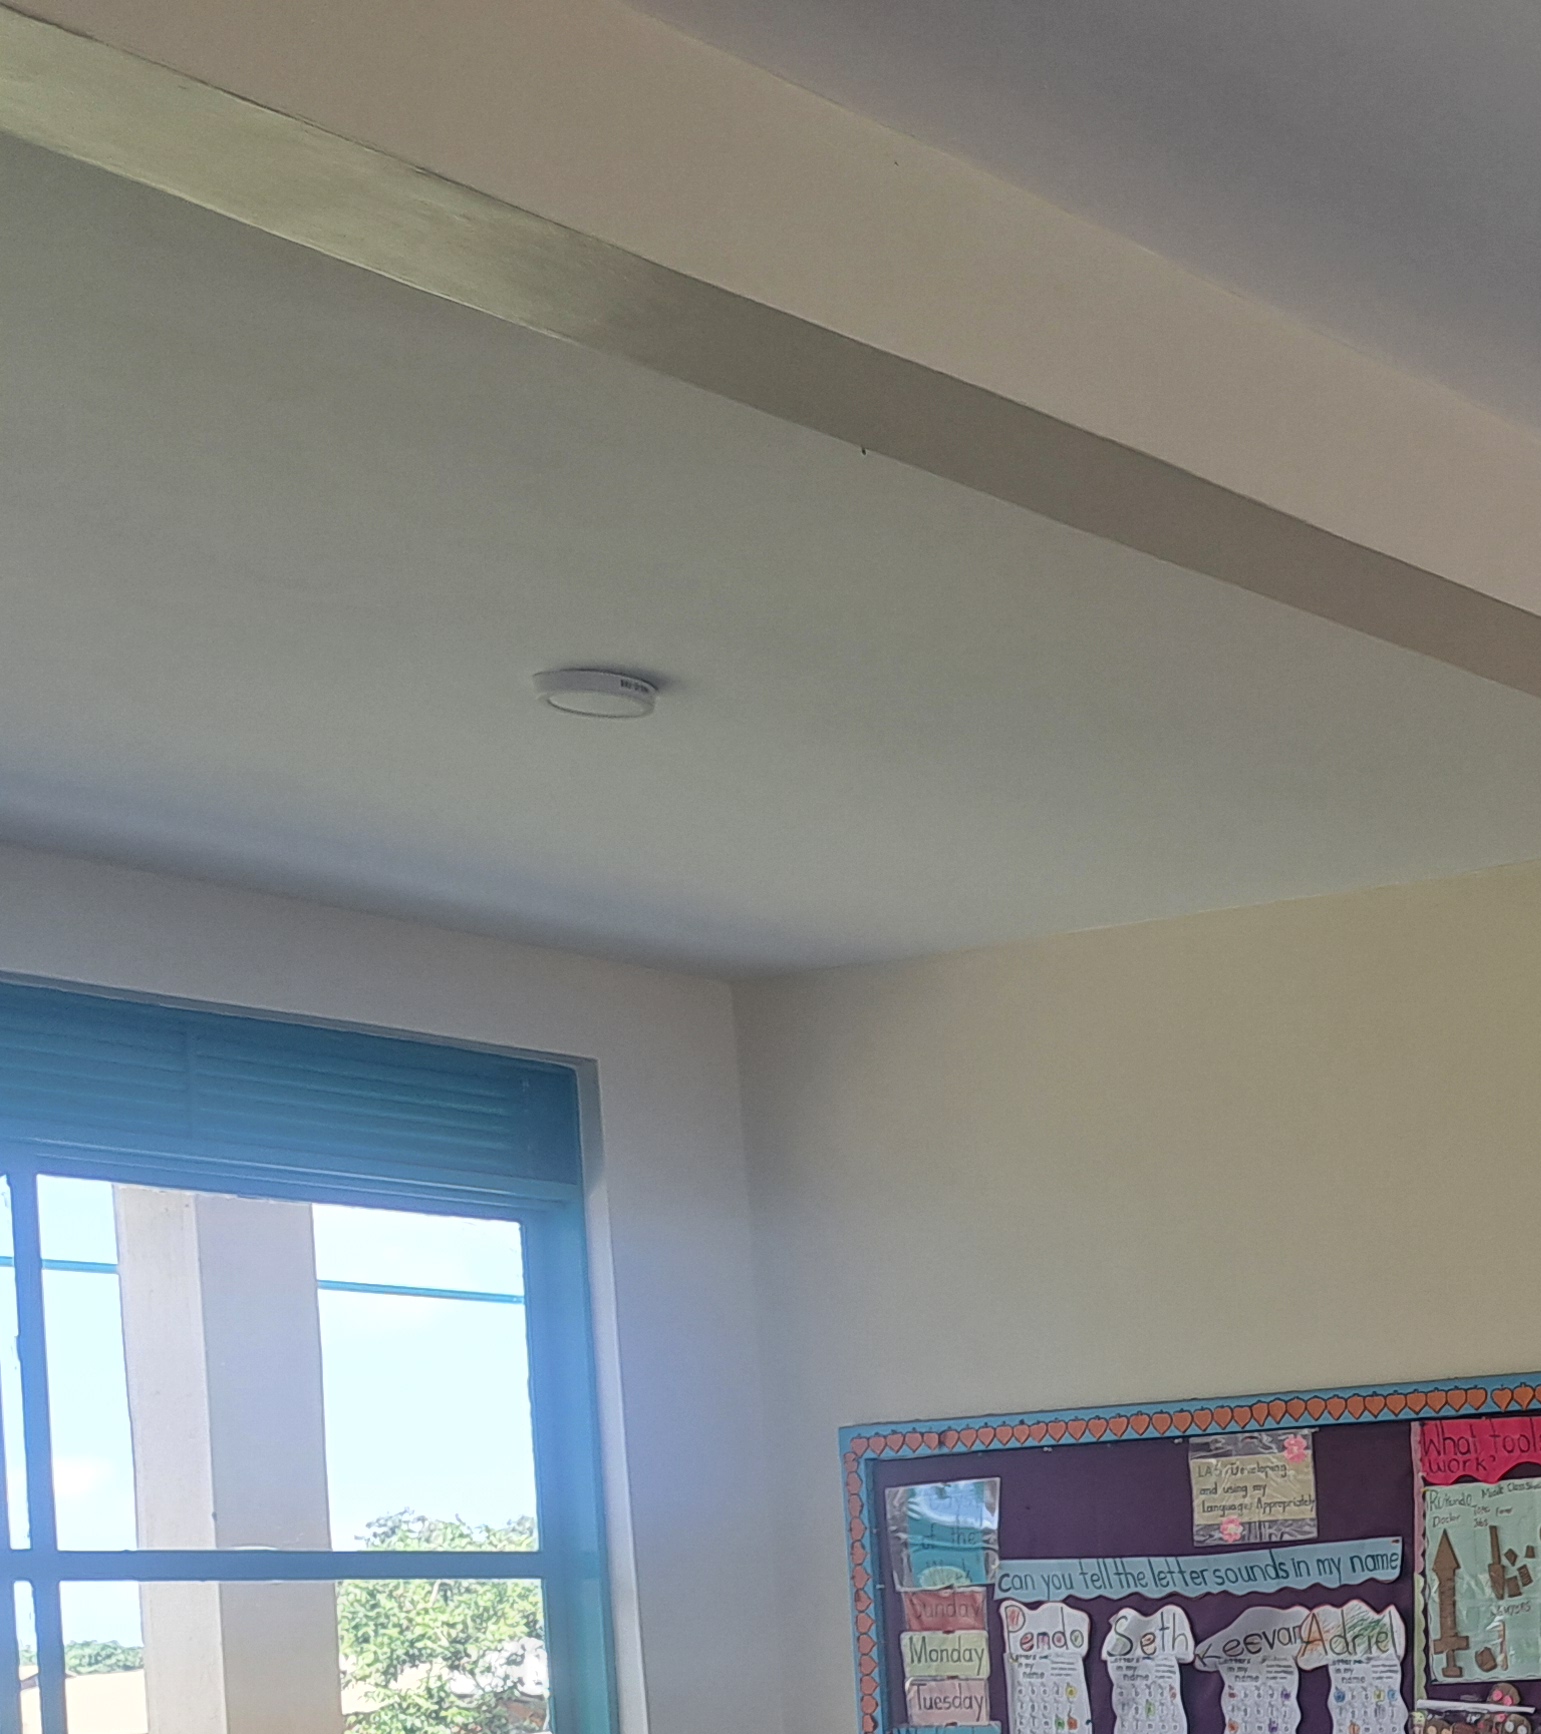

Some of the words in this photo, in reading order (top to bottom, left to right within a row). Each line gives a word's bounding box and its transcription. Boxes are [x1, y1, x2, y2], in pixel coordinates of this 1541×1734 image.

[1421, 1419, 1478, 1457] What
[998, 1573, 1036, 1592] can
[1040, 1572, 1074, 1600] you
[1079, 1558, 1113, 1590] tell
[1113, 1557, 1149, 1589] the
[1148, 1557, 1209, 1588] letter
[1213, 1549, 1290, 1586] sounds
[1290, 1556, 1310, 1577] in
[1316, 1556, 1342, 1585] my
[1349, 1551, 1399, 1574] name
[908, 1635, 985, 1677] Monday
[1004, 1604, 1085, 1661] Pendo
[1107, 1610, 1189, 1657] Seth
[1302, 1608, 1396, 1658] Adriel
[912, 1682, 985, 1722] Tuesday
